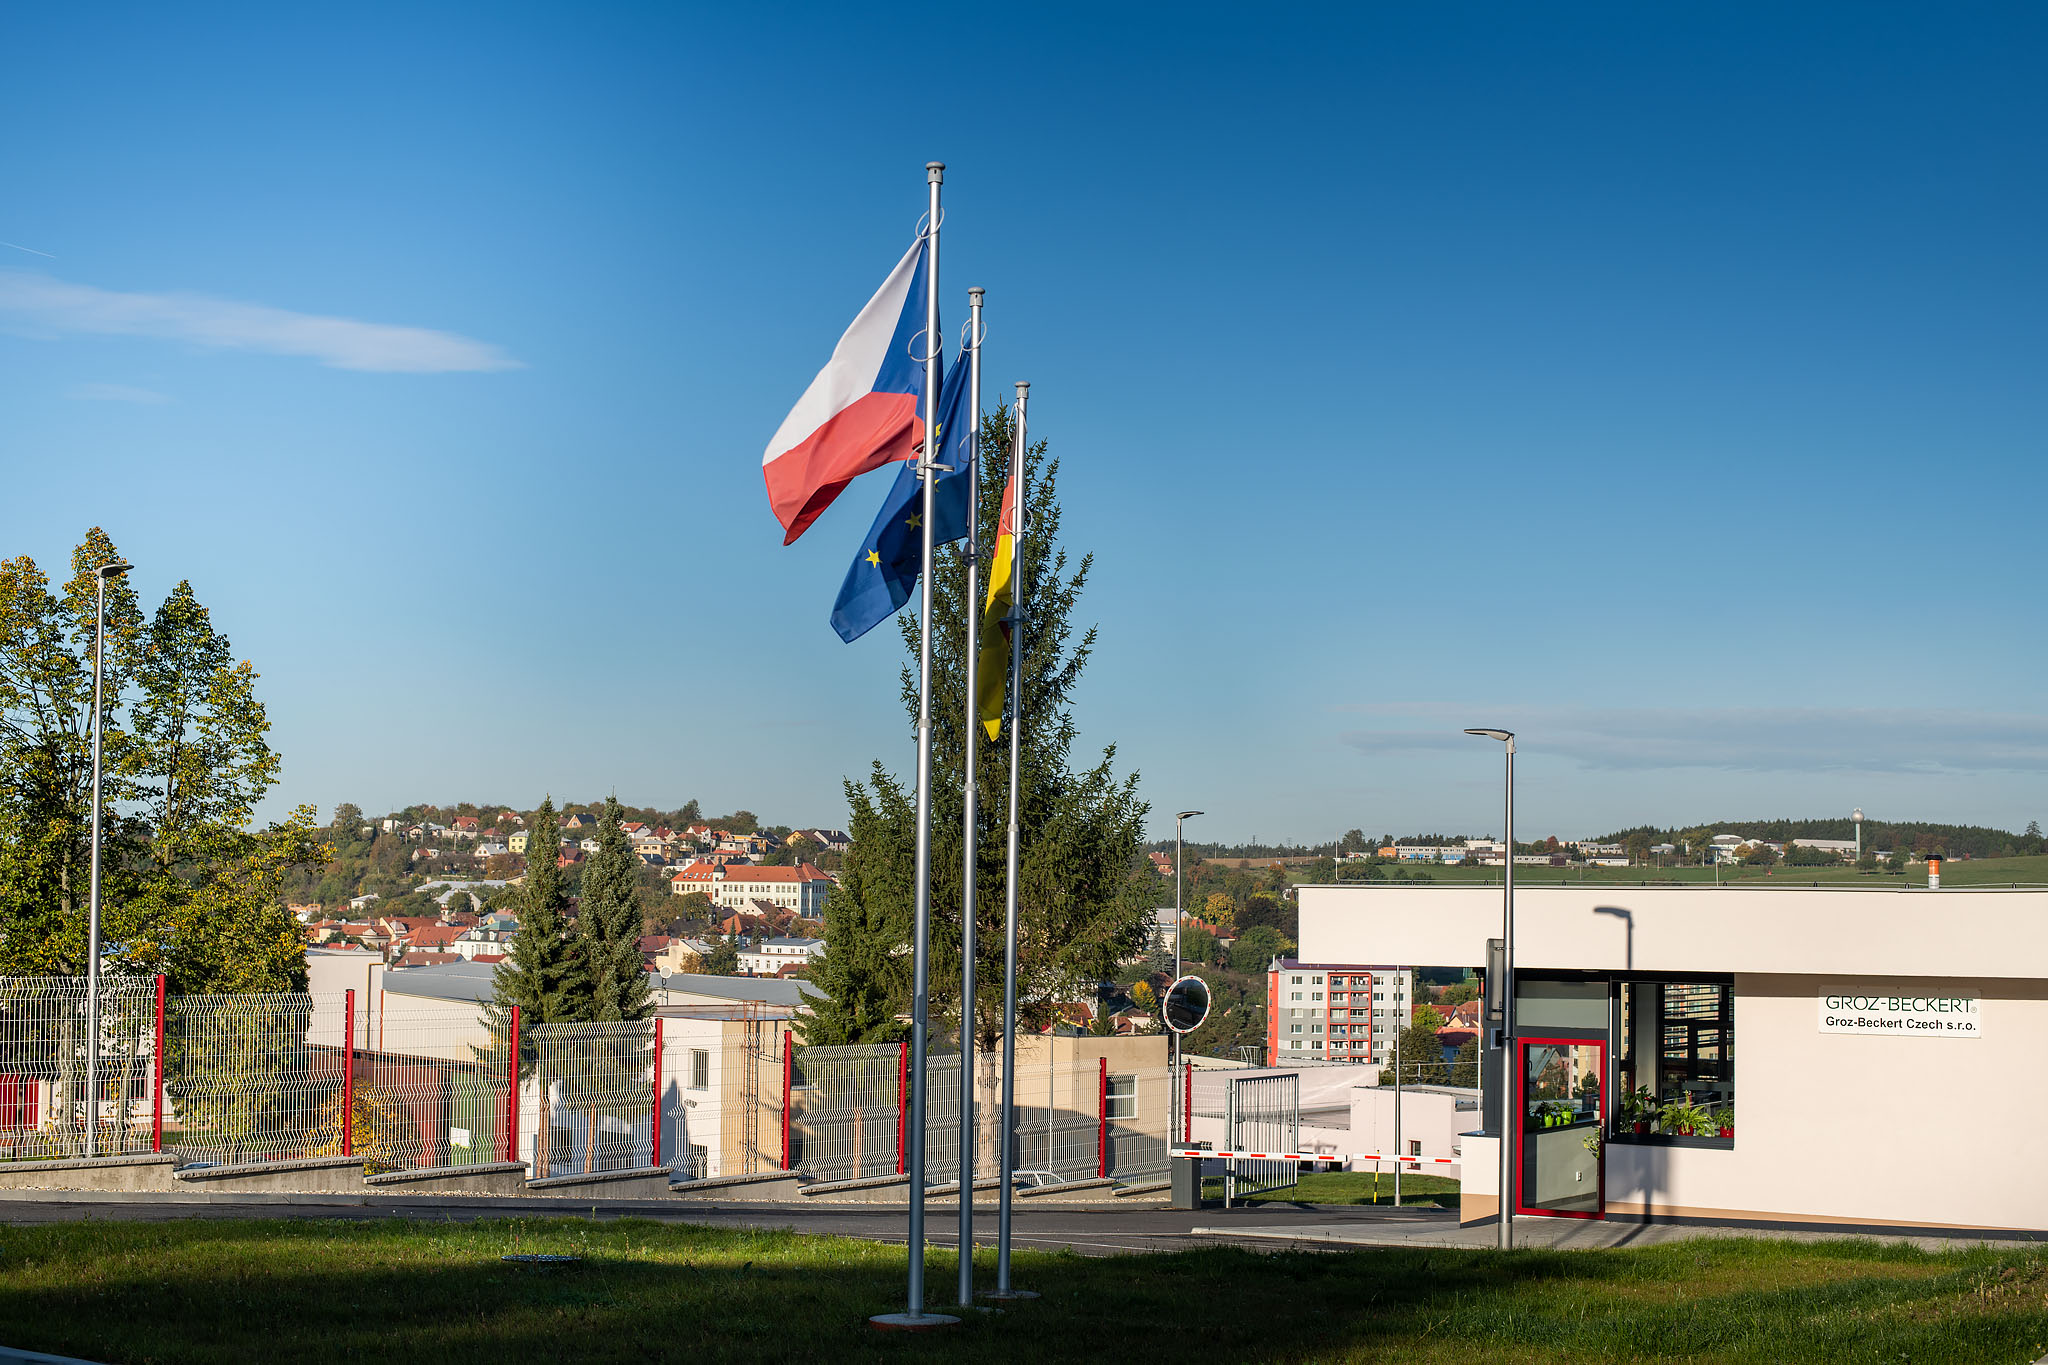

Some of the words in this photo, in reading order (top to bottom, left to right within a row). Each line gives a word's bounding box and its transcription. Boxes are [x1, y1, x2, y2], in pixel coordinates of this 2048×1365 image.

[1825, 1016, 1902, 1029] Groz-Beckert
[1906, 1019, 1943, 1030] Czech
[1946, 1022, 1976, 1031] s.r.o.
